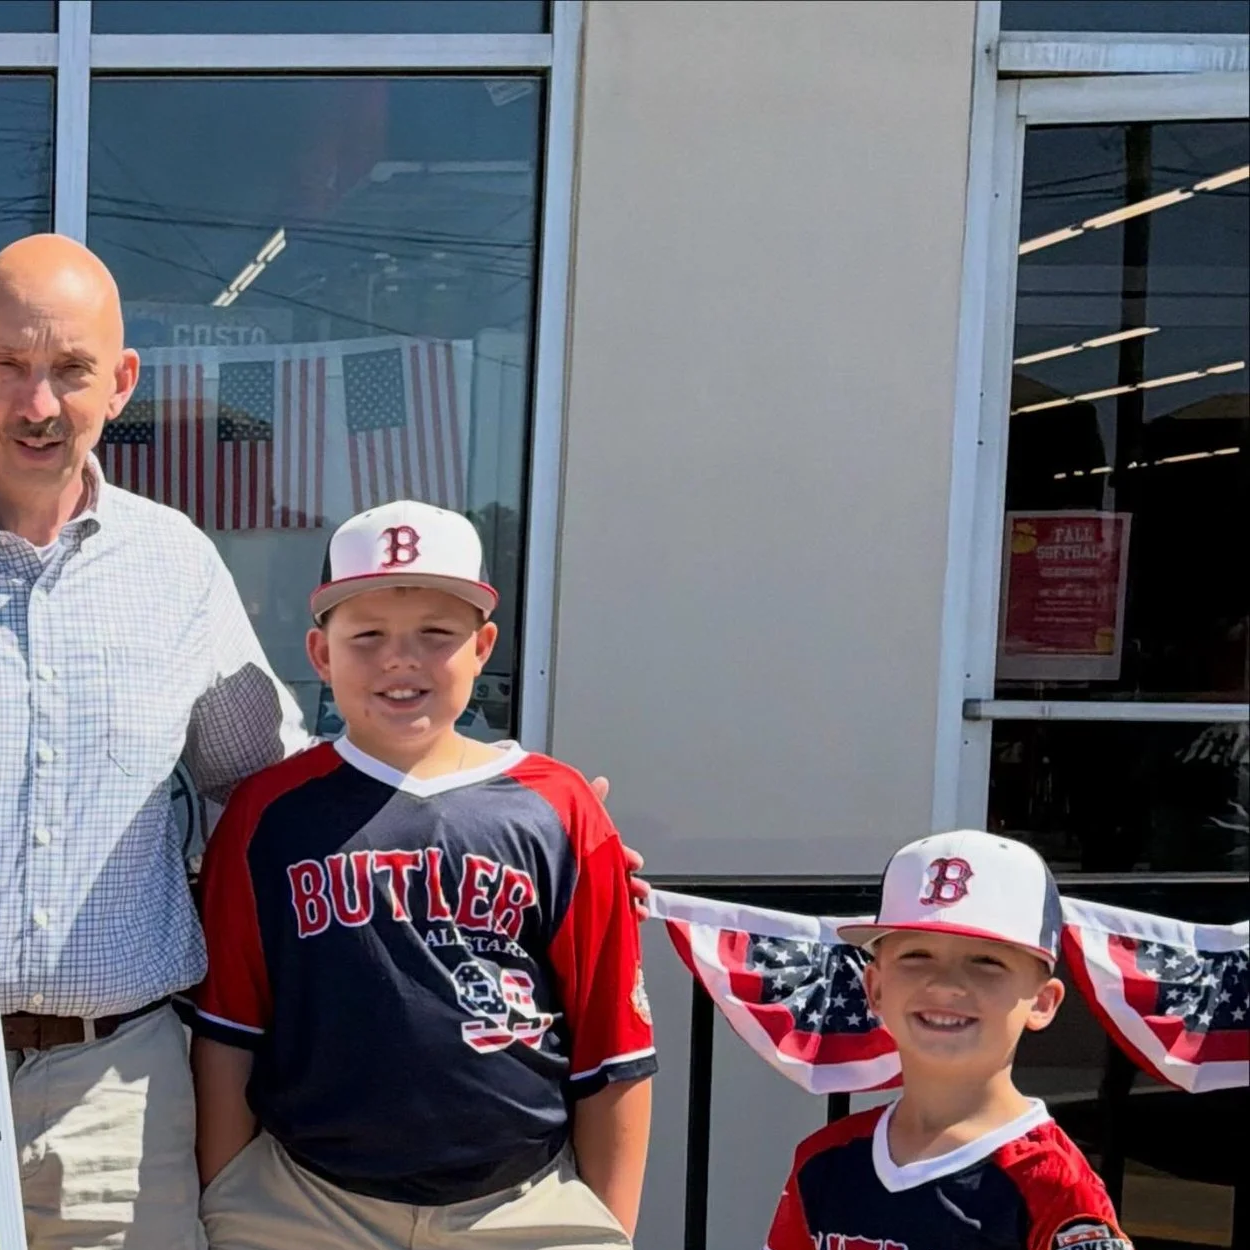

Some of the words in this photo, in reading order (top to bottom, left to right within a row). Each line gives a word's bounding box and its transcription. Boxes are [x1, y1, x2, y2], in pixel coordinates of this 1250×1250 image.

[173, 324, 267, 346] COSTA
[378, 526, 421, 568] B
[1054, 527, 1094, 542] FALL
[1036, 545, 1107, 560] SOFTBAL
[286, 847, 537, 941] BUTLER
[919, 857, 975, 907] B
